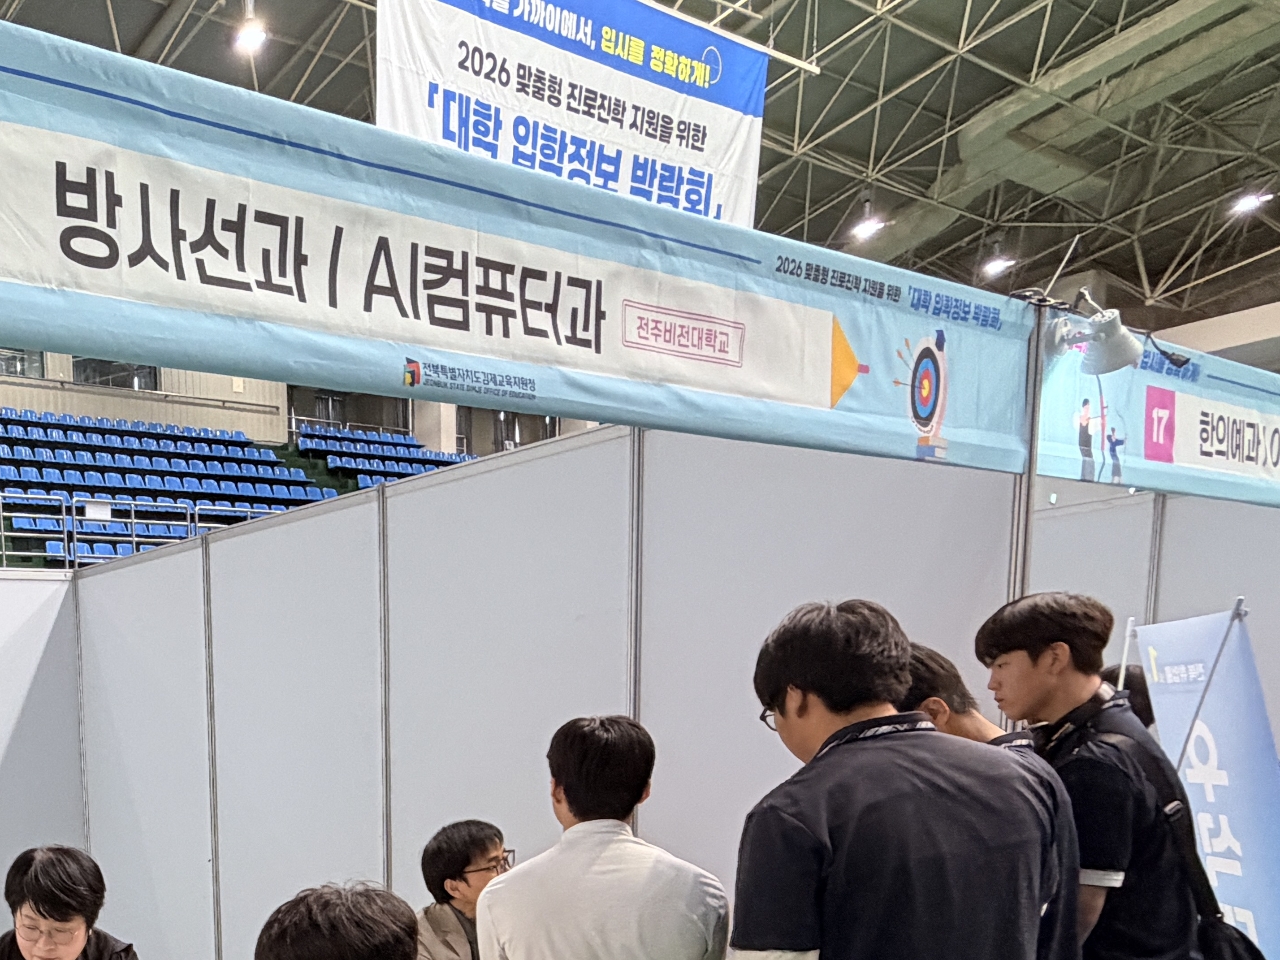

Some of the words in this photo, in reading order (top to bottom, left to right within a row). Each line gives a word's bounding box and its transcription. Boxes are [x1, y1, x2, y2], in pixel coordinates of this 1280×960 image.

[649, 44, 711, 89] 정확하게!
[458, 41, 511, 88] 2026
[515, 63, 562, 108] 맞춤형
[566, 82, 627, 129] 진로진학
[629, 104, 674, 145] 지원을
[675, 121, 707, 153] 위한
[511, 115, 623, 193] 입학정보
[54, 160, 308, 303] 방사선과
[363, 235, 606, 354] AI컴퓨터과
[775, 255, 803, 277] 2026
[804, 262, 829, 285] 맞춤형
[830, 269, 862, 293] 진로진학
[862, 278, 885, 299] 지원을
[886, 284, 902, 303] 위한
[932, 292, 971, 322] 입학정보
[636, 316, 730, 355] 전주비전대학교
[422, 362, 536, 392] 전북특별자치도김제교육지원청
[449, 382, 465, 391] STATE
[1152, 407, 1170, 444] 17
[1199, 410, 1261, 466] 한의예과
